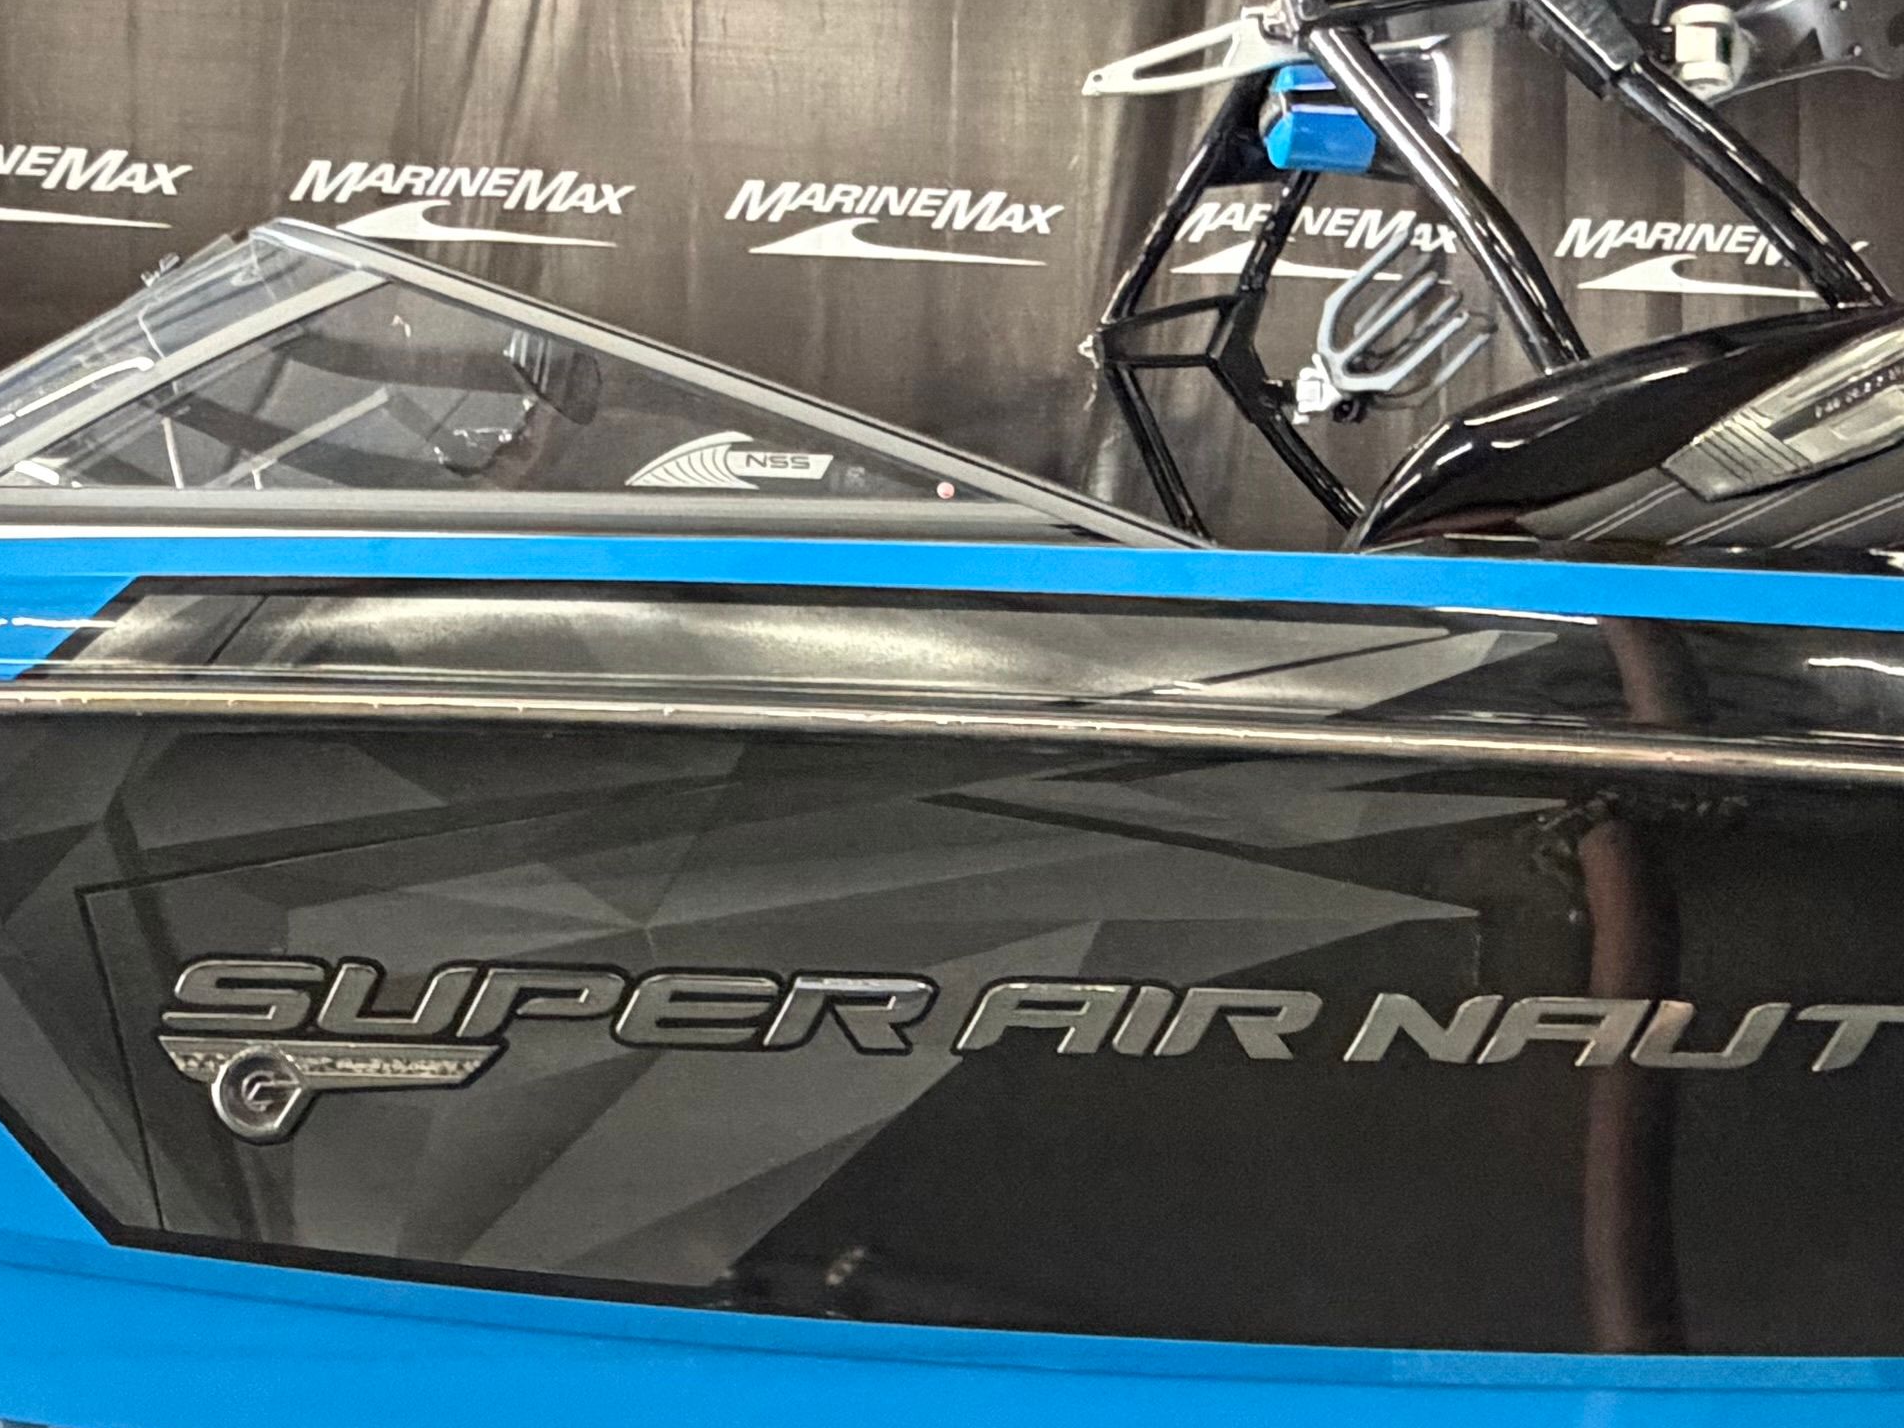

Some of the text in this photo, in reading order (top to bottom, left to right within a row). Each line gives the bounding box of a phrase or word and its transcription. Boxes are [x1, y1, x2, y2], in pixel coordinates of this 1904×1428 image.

[744, 453, 811, 471] NSS
[162, 960, 932, 1053] SUPER
[957, 981, 1323, 1059] AIR
